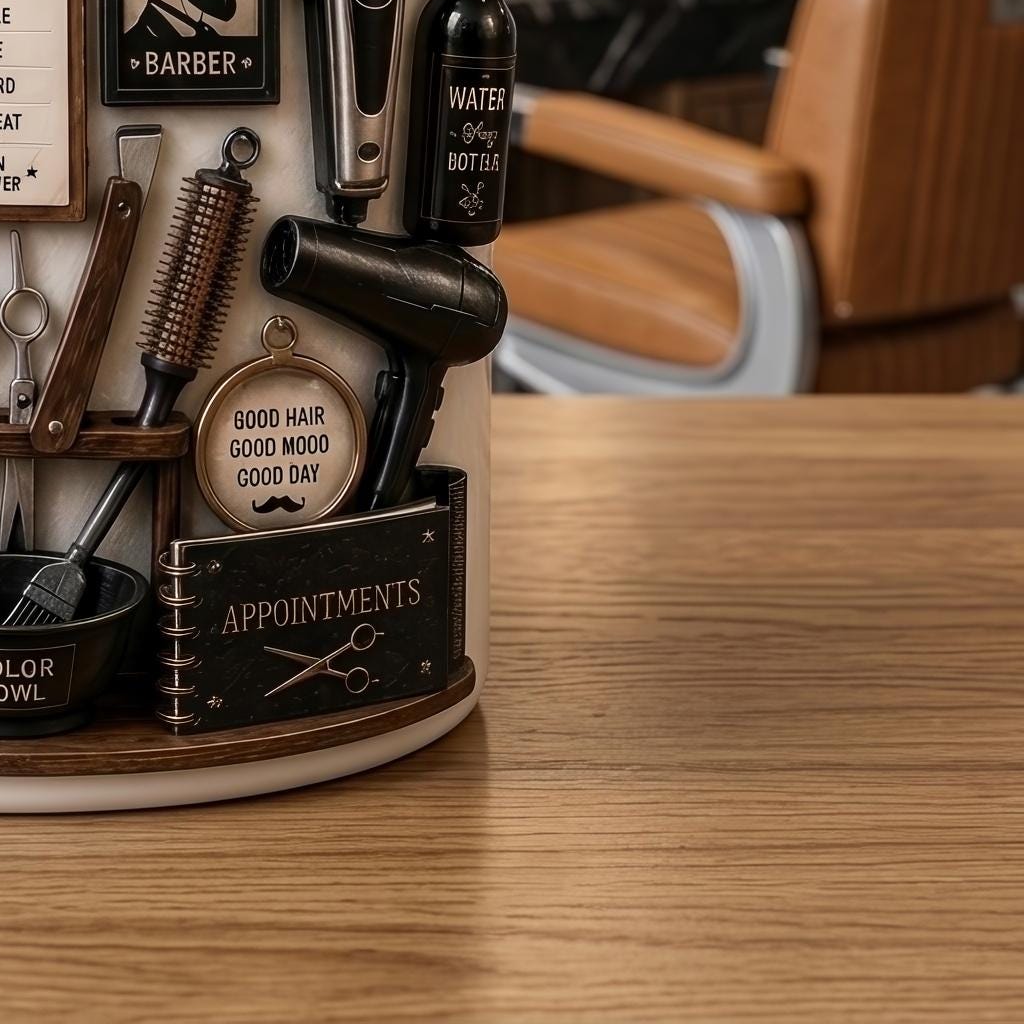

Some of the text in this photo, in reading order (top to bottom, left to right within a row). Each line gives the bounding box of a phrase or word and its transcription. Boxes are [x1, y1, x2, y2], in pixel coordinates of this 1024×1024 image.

[145, 51, 236, 75] BARBER
[449, 85, 505, 111] WATER
[234, 406, 325, 430] GOOD HAIR
[230, 437, 276, 458] GOOD
[237, 463, 320, 487] GOOD DAY
[222, 578, 421, 635] APPOINTMENTS
